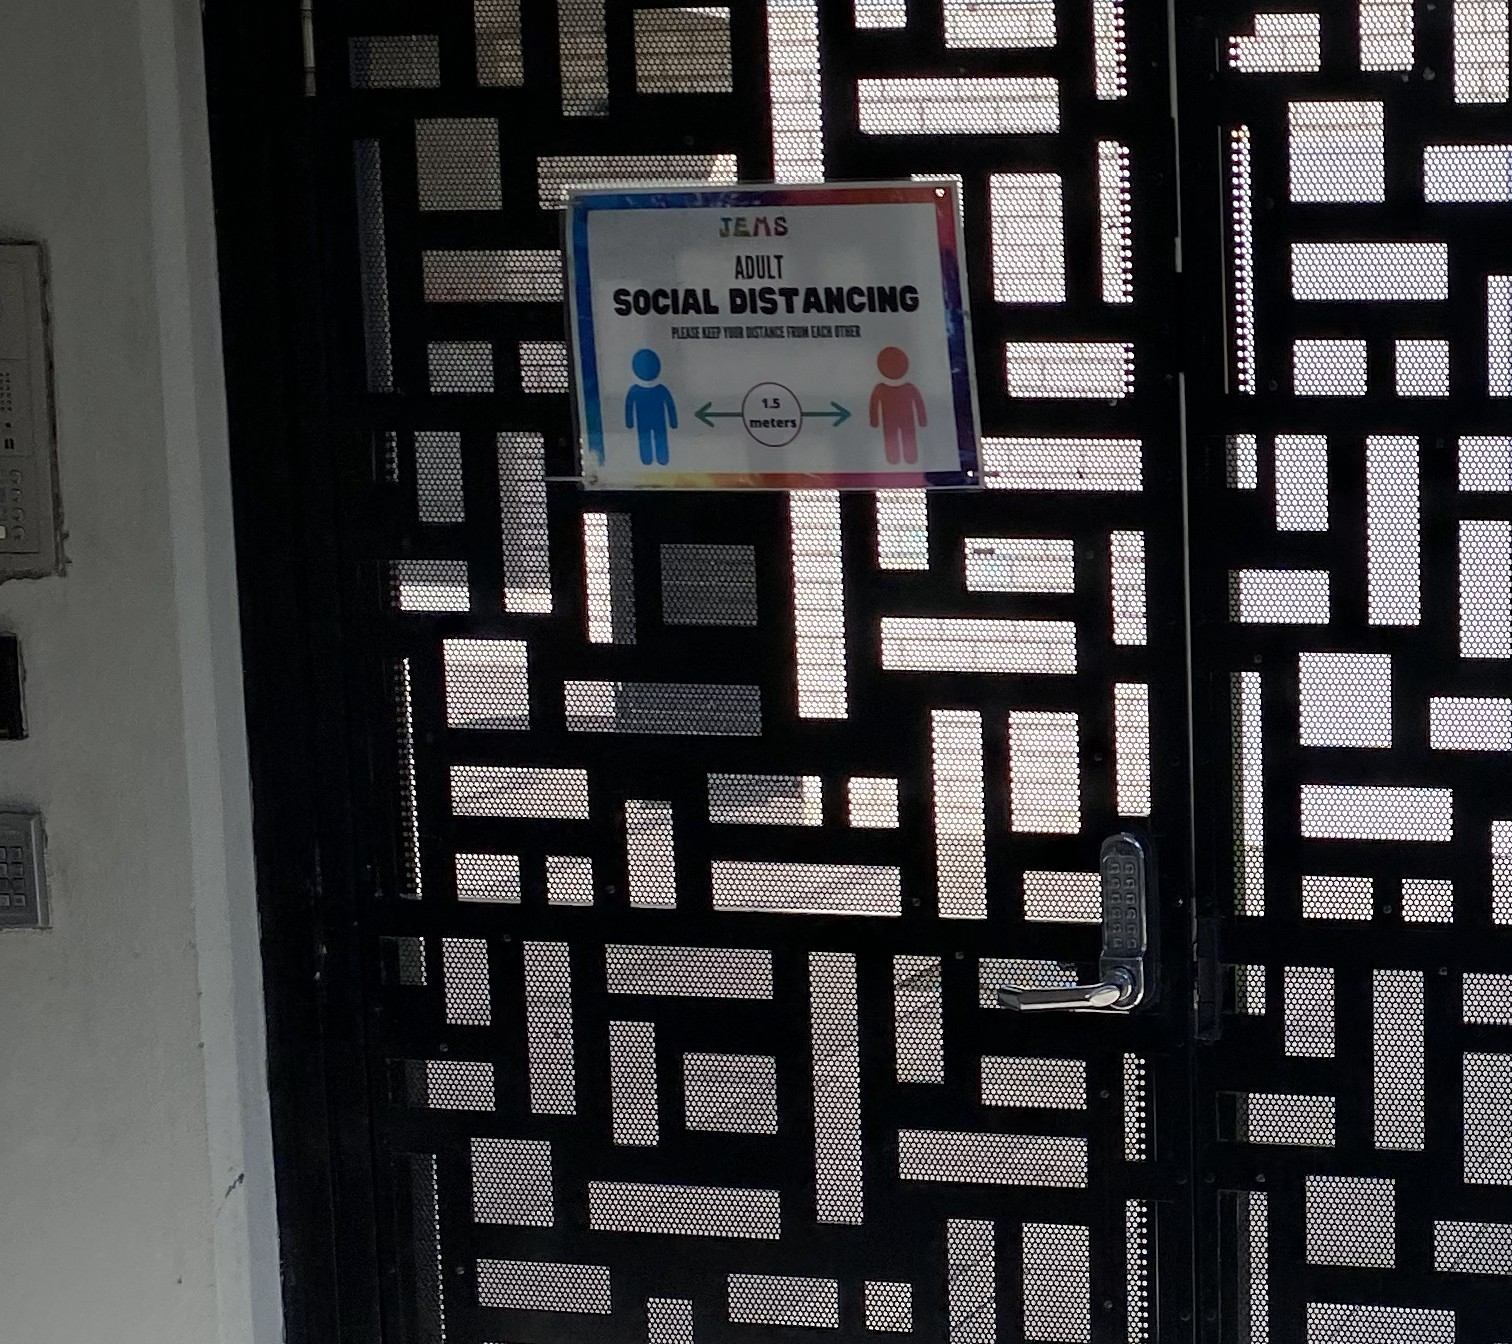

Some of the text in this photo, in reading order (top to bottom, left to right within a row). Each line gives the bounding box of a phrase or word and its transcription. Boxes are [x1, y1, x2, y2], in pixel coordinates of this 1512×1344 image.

[719, 216, 789, 237] JEMS
[735, 254, 784, 280] ADULT
[612, 285, 921, 317] SOCIAL DISTANCING
[671, 325, 861, 340] PLEASE KEEP YOUR DISTANCE FROM EACH OTHER
[762, 398, 780, 409] 1.5
[749, 418, 797, 428] meters
